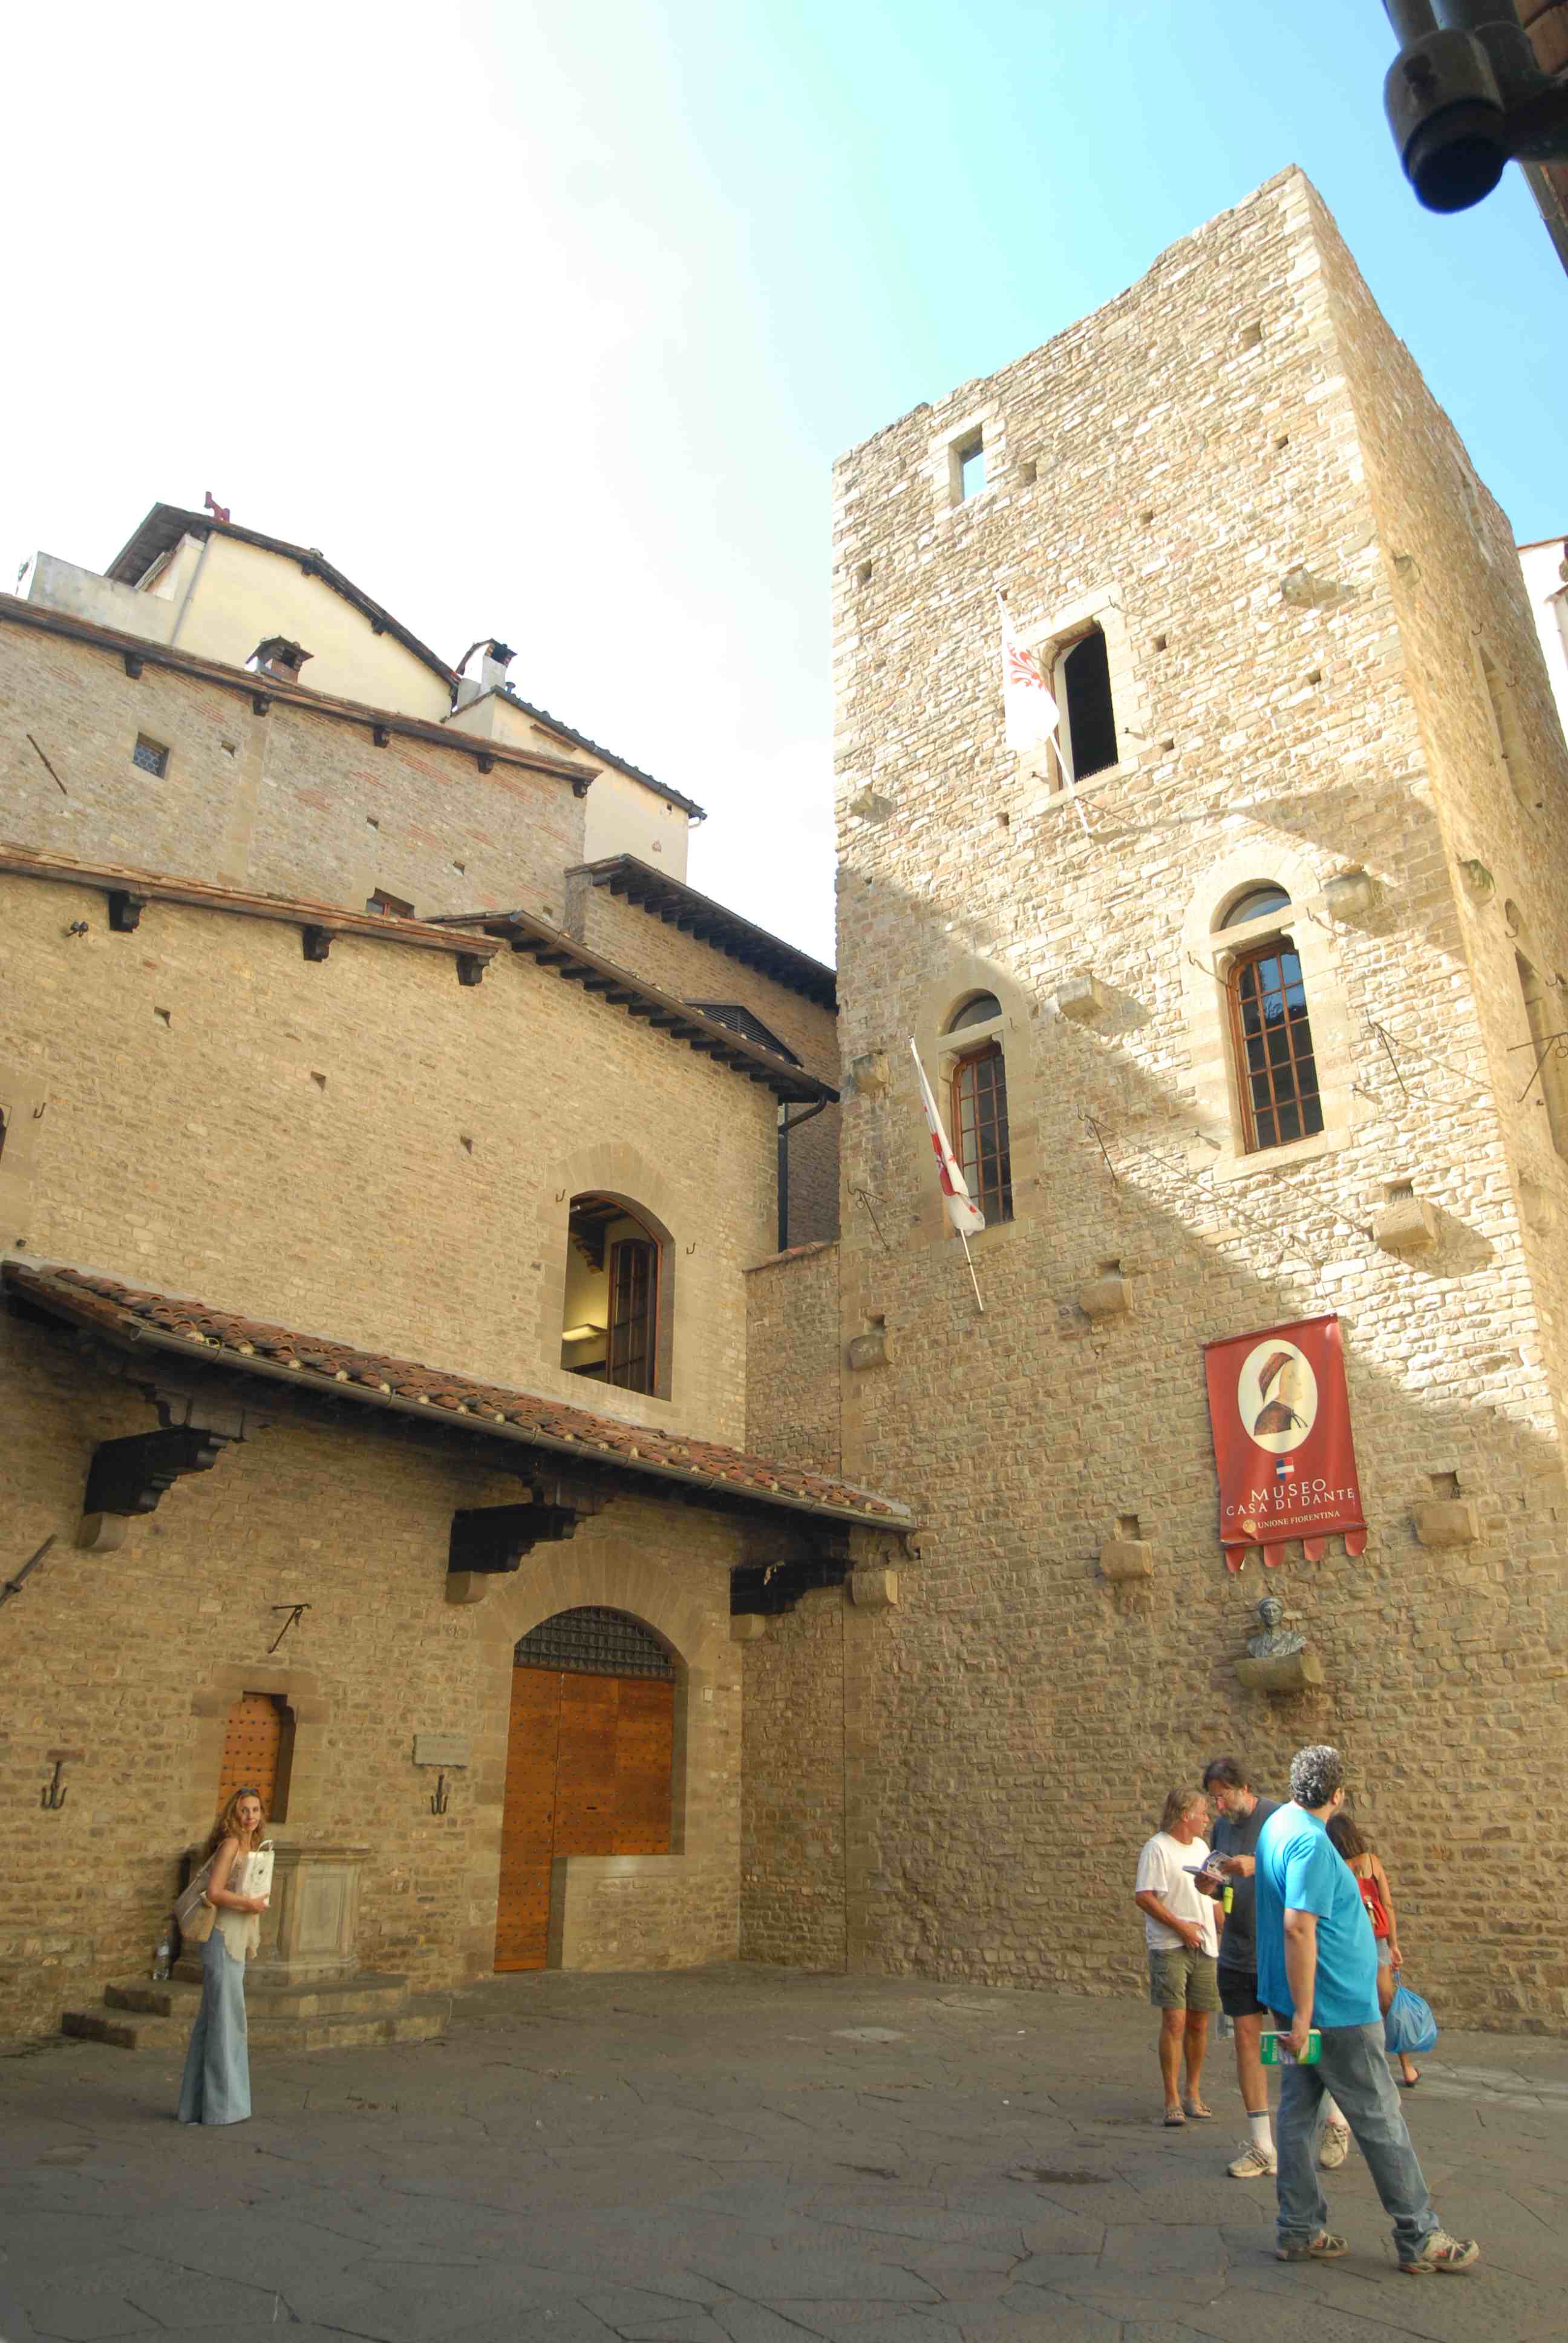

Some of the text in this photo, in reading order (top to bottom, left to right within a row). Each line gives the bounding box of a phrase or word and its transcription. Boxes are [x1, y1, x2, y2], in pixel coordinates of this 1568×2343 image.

[1251, 1478, 1326, 1501] MUSEO
[1226, 1488, 1354, 1516] CASA DI DANTE
[1258, 1510, 1340, 1529] UNIONE FIORENTINA
